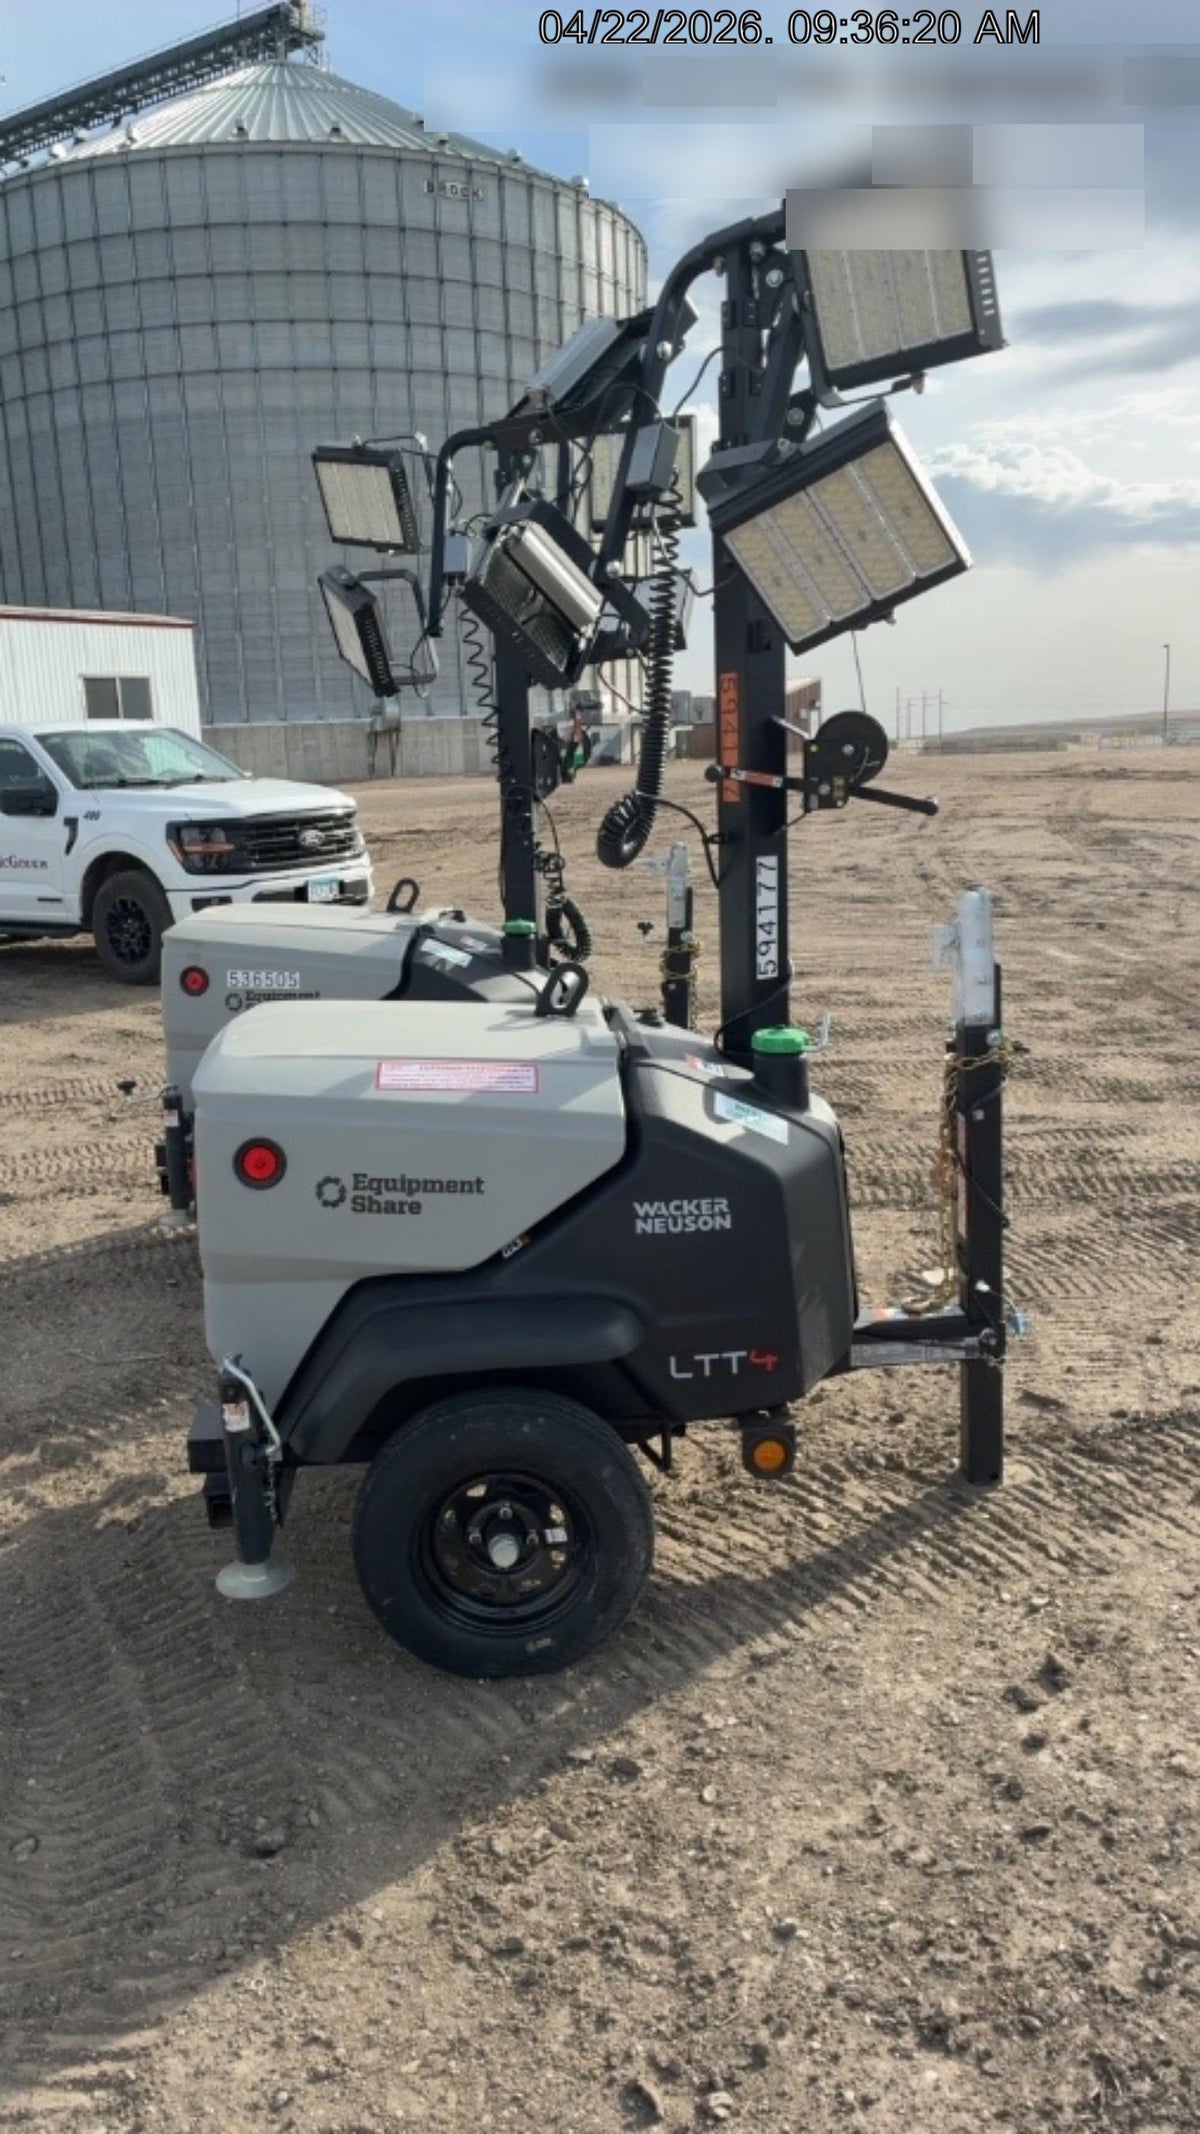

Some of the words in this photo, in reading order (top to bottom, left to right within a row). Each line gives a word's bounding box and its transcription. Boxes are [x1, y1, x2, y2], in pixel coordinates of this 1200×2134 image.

[721, 676, 740, 799] 59417
[756, 860, 778, 977] 594177
[228, 970, 299, 989] 536505
[352, 1173, 485, 1197] Equipment
[352, 1195, 423, 1215] Share
[633, 1197, 730, 1217] WACKER
[635, 1213, 732, 1234] NEUSON
[669, 1348, 779, 1378] LTT4
